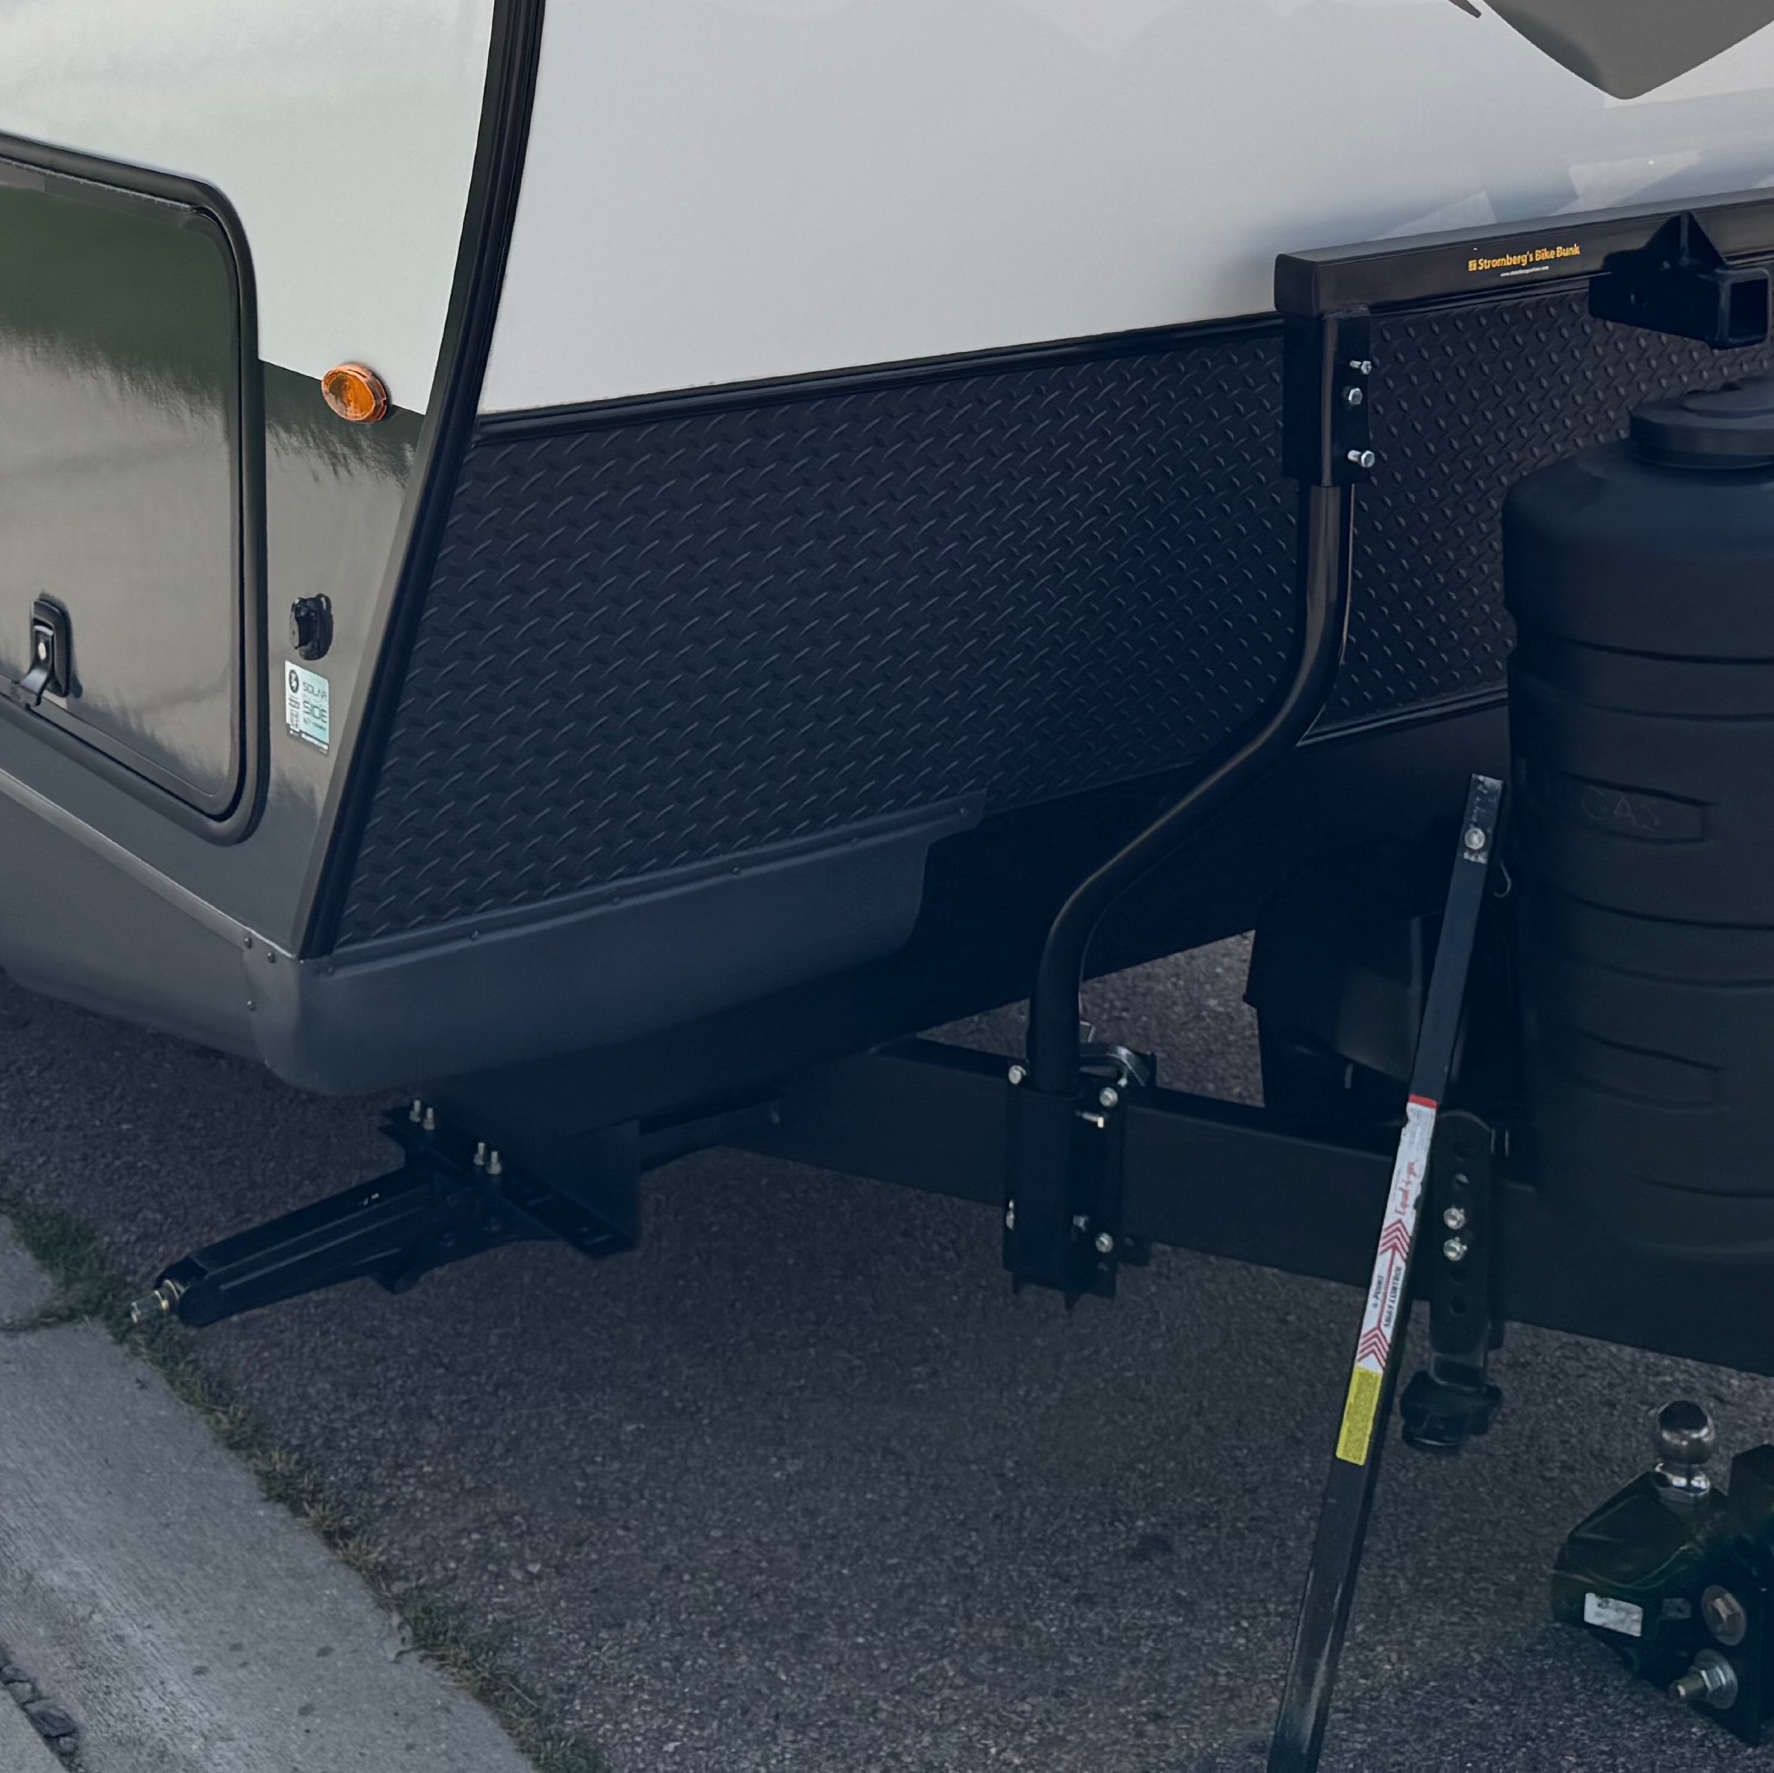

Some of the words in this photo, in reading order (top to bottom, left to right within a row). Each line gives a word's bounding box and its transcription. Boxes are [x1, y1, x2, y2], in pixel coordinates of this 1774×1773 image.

[1478, 251, 1533, 270] Stromberg's
[1535, 248, 1555, 262] Bike
[1556, 243, 1580, 257] Bunk
[1582, 785, 1661, 834] GAS
